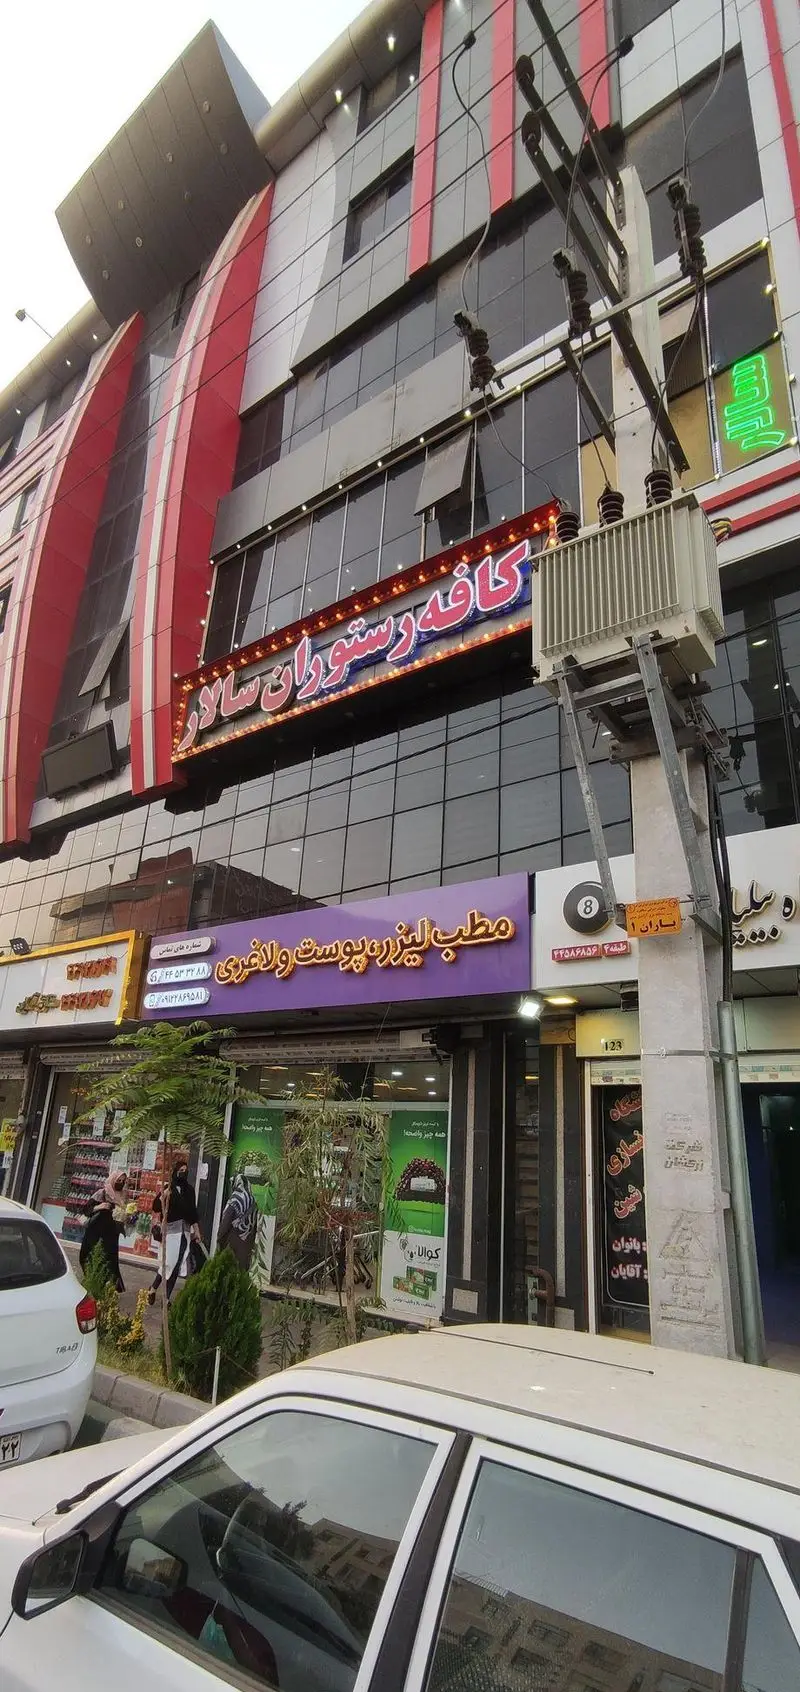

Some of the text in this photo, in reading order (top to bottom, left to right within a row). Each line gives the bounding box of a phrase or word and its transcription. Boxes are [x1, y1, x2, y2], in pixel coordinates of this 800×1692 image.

[177, 539, 532, 752] کافه رستوران سالار
[582, 899, 593, 915] 8
[639, 919, 677, 934] باران
[186, 941, 202, 951] شماره
[433, 910, 515, 963] مطب
[293, 937, 368, 974] پوست
[604, 1041, 623, 1052] 123
[609, 1090, 642, 1122] شگاه
[607, 1129, 644, 1176] نسازی
[612, 1236, 641, 1255] بانوان
[610, 1263, 642, 1280] آقایان
